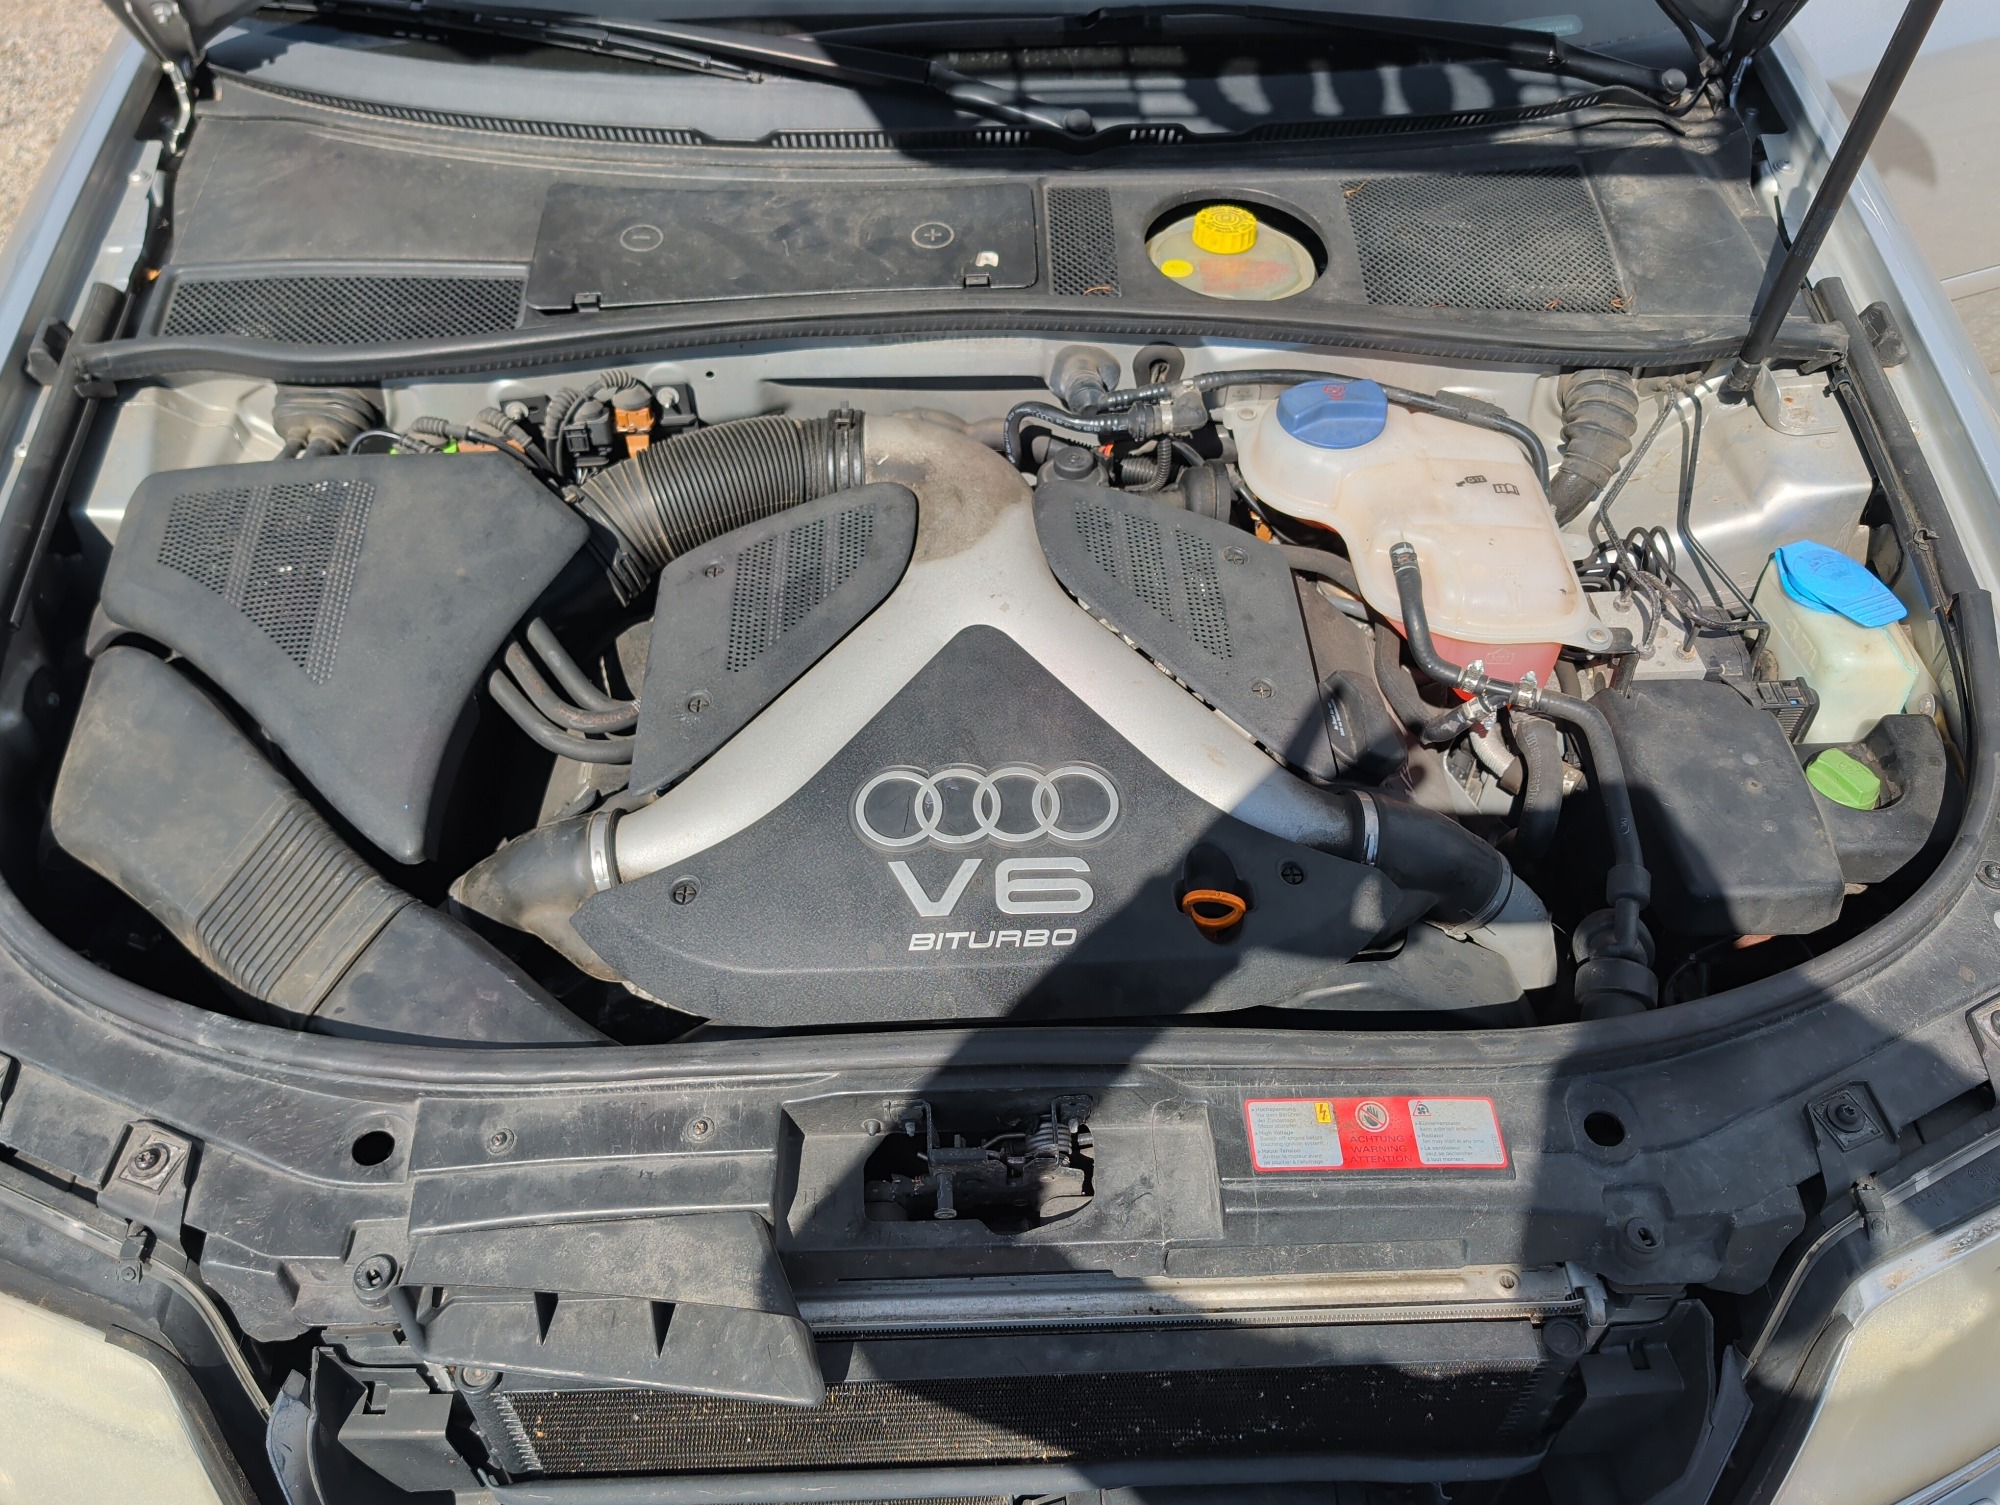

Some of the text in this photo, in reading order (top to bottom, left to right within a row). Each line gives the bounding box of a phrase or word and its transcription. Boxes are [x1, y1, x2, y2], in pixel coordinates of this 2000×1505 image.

[887, 856, 1094, 917] V6
[908, 928, 1078, 951] BITURBO
[1350, 1135, 1405, 1143] ACHTUNG
[1350, 1145, 1408, 1153] WARNING
[1350, 1155, 1412, 1163] ATTENTION
